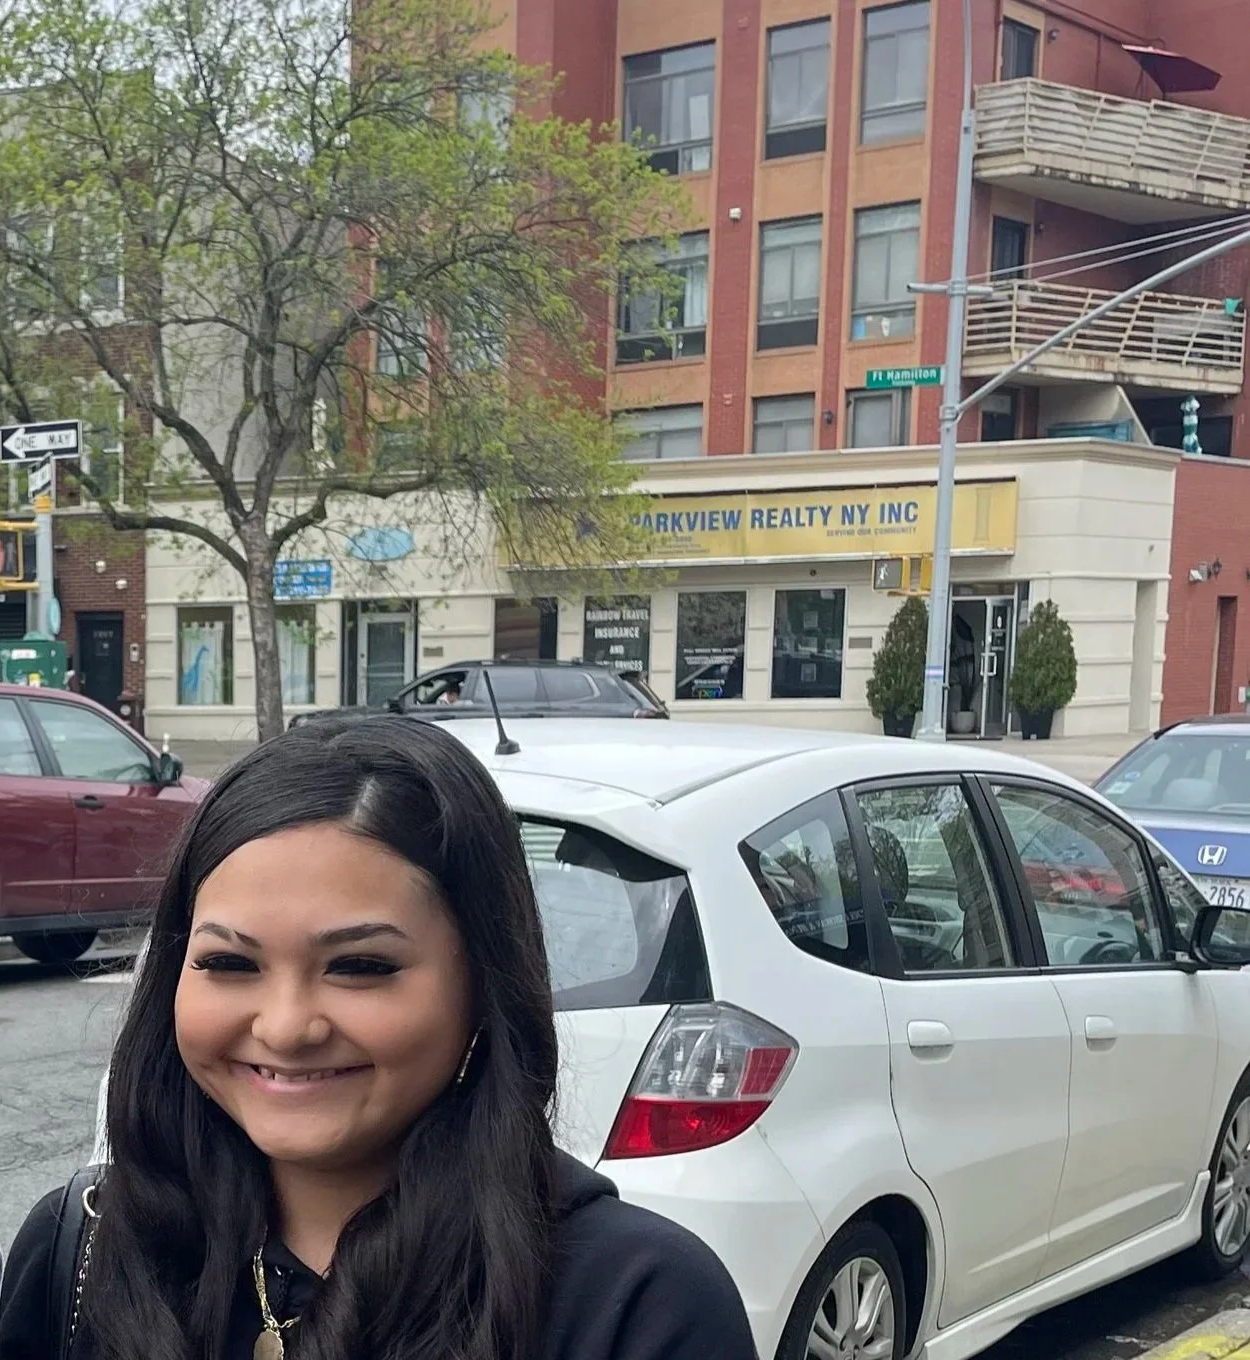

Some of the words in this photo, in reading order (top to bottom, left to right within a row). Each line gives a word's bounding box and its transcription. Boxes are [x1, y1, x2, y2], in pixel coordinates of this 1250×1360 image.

[873, 371, 883, 382] Ft
[887, 368, 937, 380] Hamilton
[14, 435, 37, 449] ONE
[47, 433, 71, 446] WAY
[750, 504, 833, 530] REALTY
[841, 503, 870, 526] NY
[879, 501, 919, 524] INC
[874, 525, 917, 535] COMMUNITY
[585, 609, 621, 621] RAINBOW
[622, 608, 649, 620] TRAVEL
[594, 626, 640, 639] INSURANCE
[609, 644, 625, 655] AND
